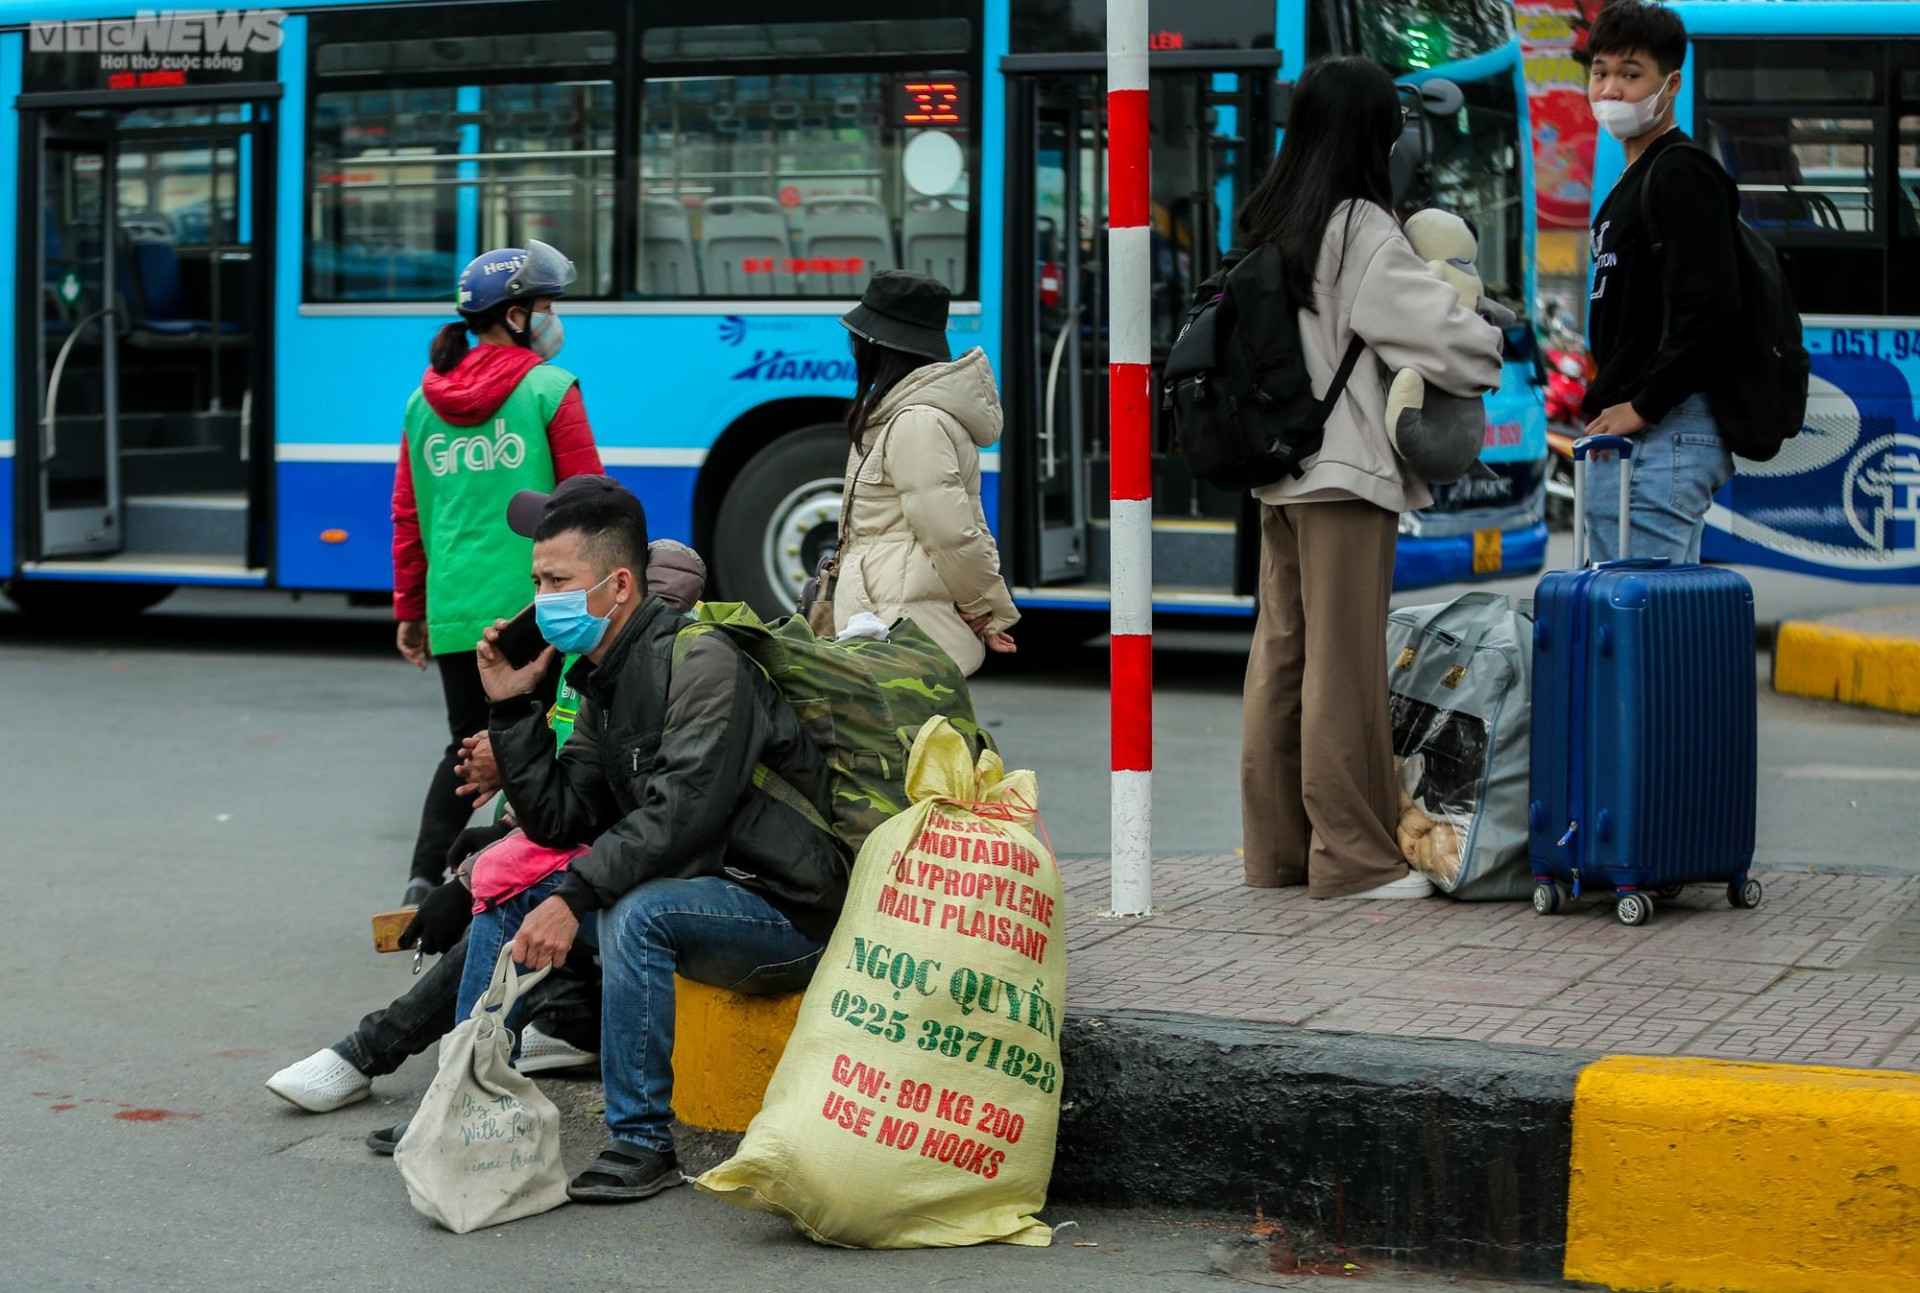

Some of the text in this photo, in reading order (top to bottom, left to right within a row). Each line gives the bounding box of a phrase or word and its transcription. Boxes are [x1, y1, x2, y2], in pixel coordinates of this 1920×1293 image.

[423, 418, 525, 477] Grab
[877, 884, 1048, 964] MALT PLAISANT
[887, 850, 1055, 929] POLYPROPYLENE
[845, 937, 941, 1001] NGỌC
[831, 989, 1056, 1094] 0225 3871828
[822, 1090, 1006, 1179] USE NO HOOKS
[831, 1053, 1025, 1144] G/W: 80 KG 200
